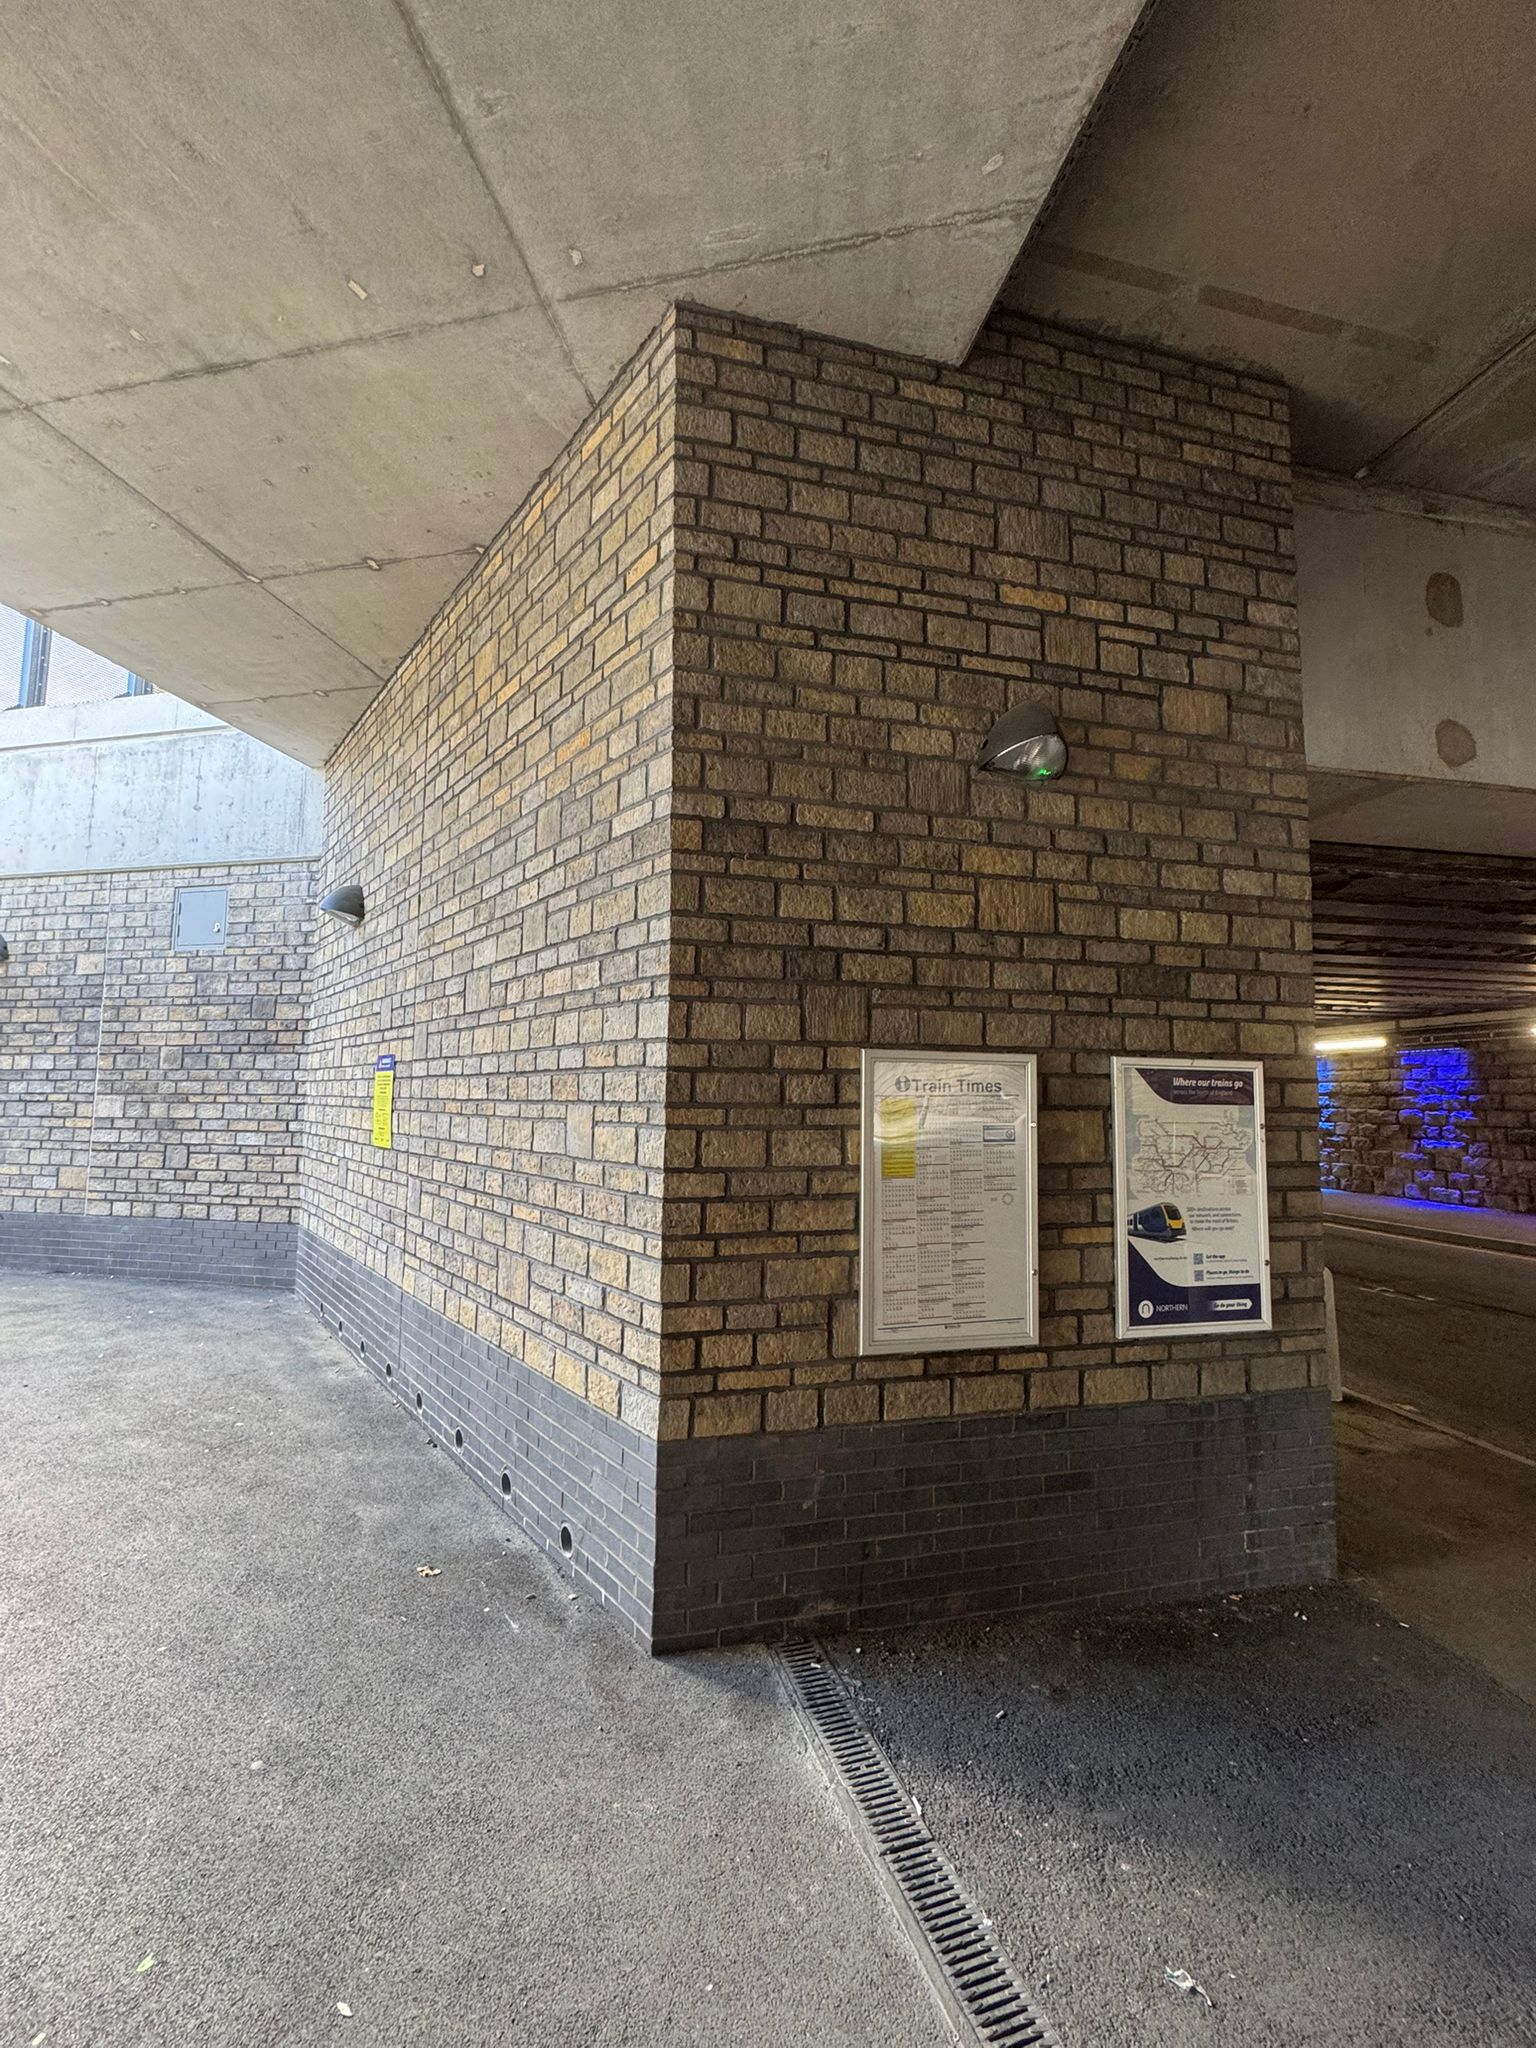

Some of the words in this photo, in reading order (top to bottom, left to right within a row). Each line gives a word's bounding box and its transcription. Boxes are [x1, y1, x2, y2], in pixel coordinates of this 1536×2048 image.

[911, 1079, 952, 1093] Train
[956, 1079, 1002, 1093] Times
[1173, 1077, 1197, 1087] Where
[1211, 1079, 1233, 1087] trains
[1234, 1081, 1243, 1089] go
[1156, 1304, 1188, 1312] NORTHERN
